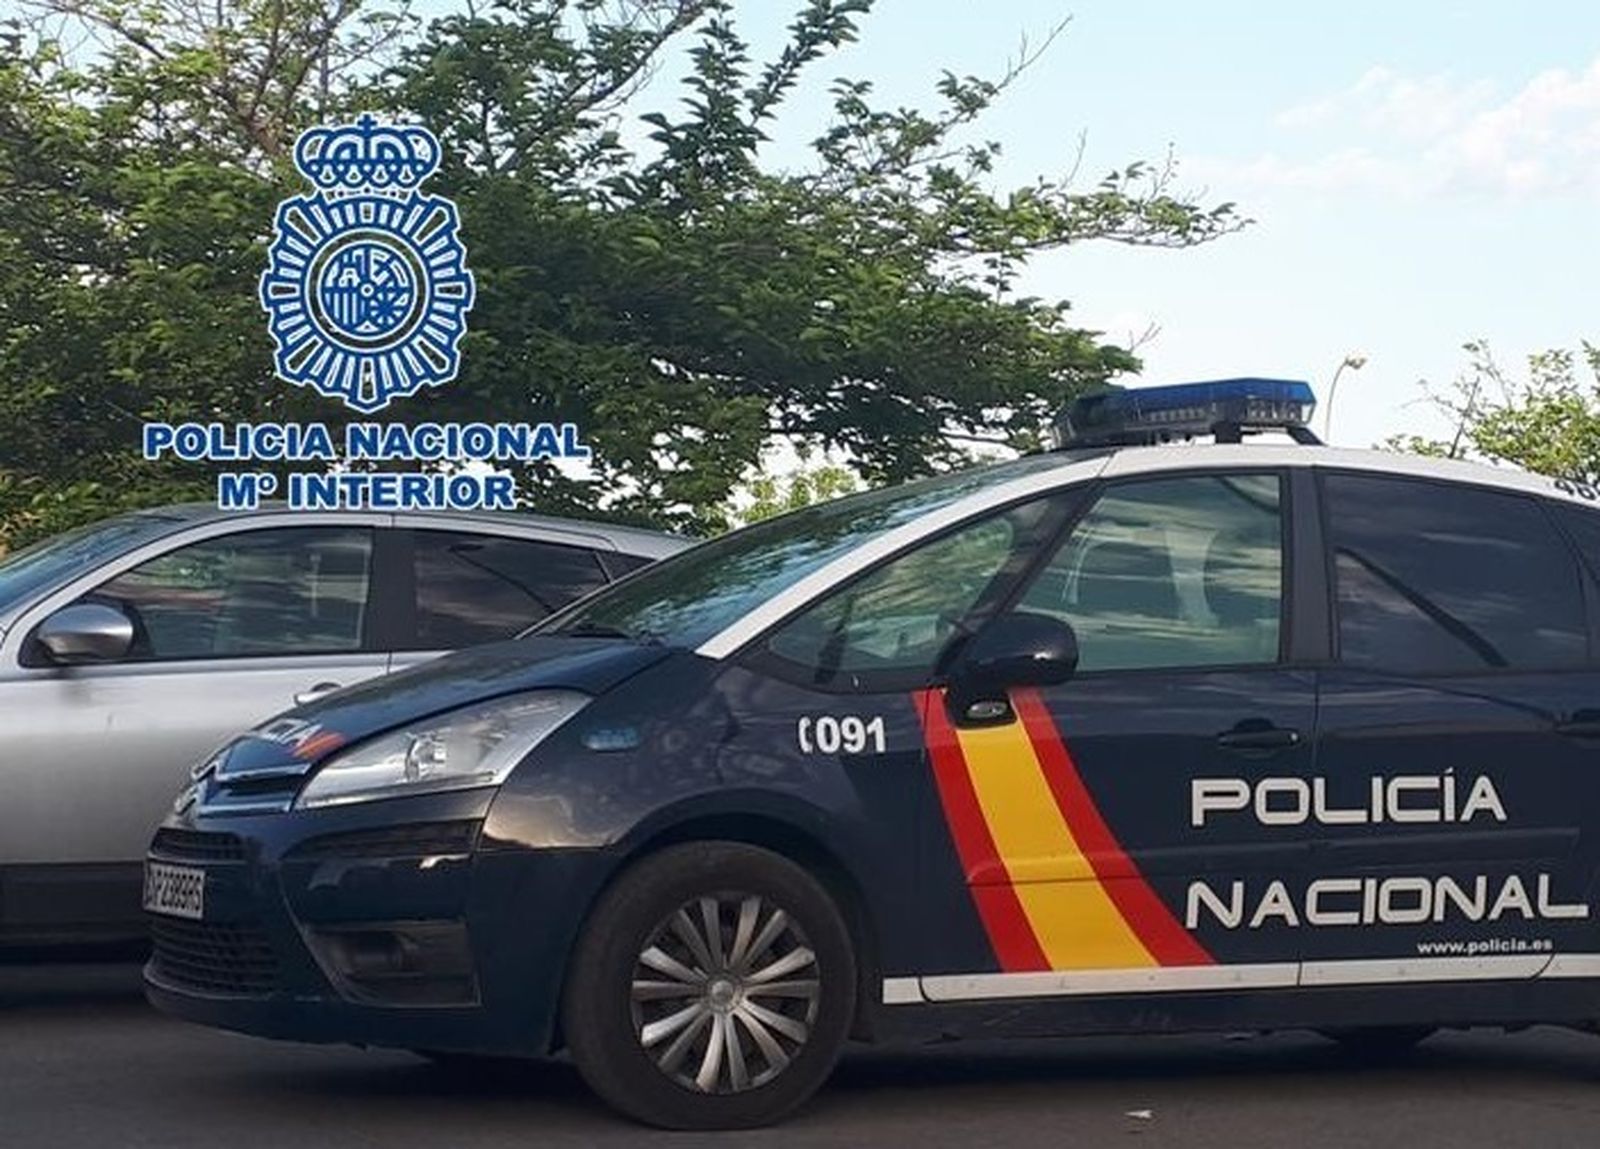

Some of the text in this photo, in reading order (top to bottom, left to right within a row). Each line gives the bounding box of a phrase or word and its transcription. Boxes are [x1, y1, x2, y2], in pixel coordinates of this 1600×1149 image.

[1191, 767, 1507, 826] POLICÍA
[1186, 874, 1589, 930] NACIONAL
[1417, 938, 1553, 956] www.policia.es
